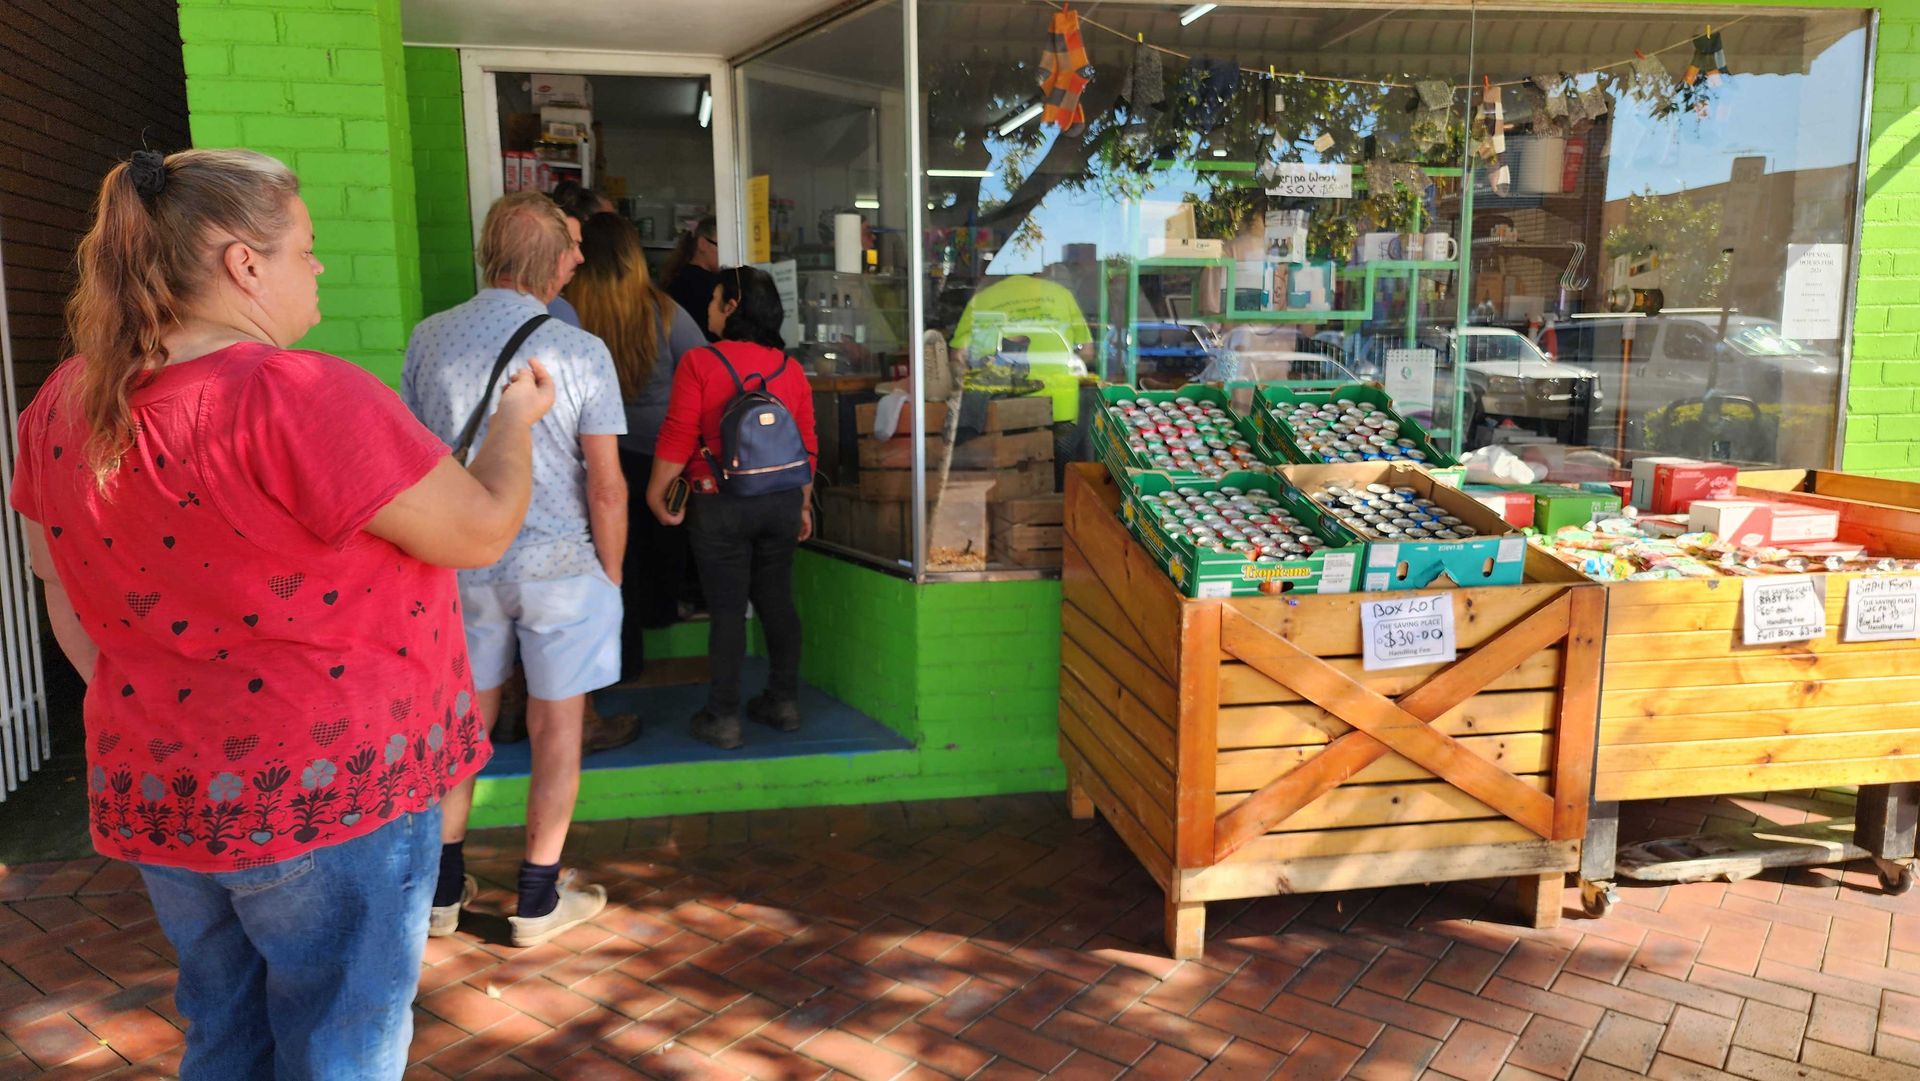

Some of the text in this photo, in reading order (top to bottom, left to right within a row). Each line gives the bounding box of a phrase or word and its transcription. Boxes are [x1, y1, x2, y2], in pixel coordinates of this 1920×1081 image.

[1281, 175, 1306, 184] erino
[1286, 184, 1316, 194] SOX
[1243, 564, 1311, 581] Tropicana
[1408, 597, 1443, 614] LOT
[1394, 620, 1419, 629] SAVING
[1420, 618, 1441, 626] PLACE
[1389, 649, 1418, 657] Handling
